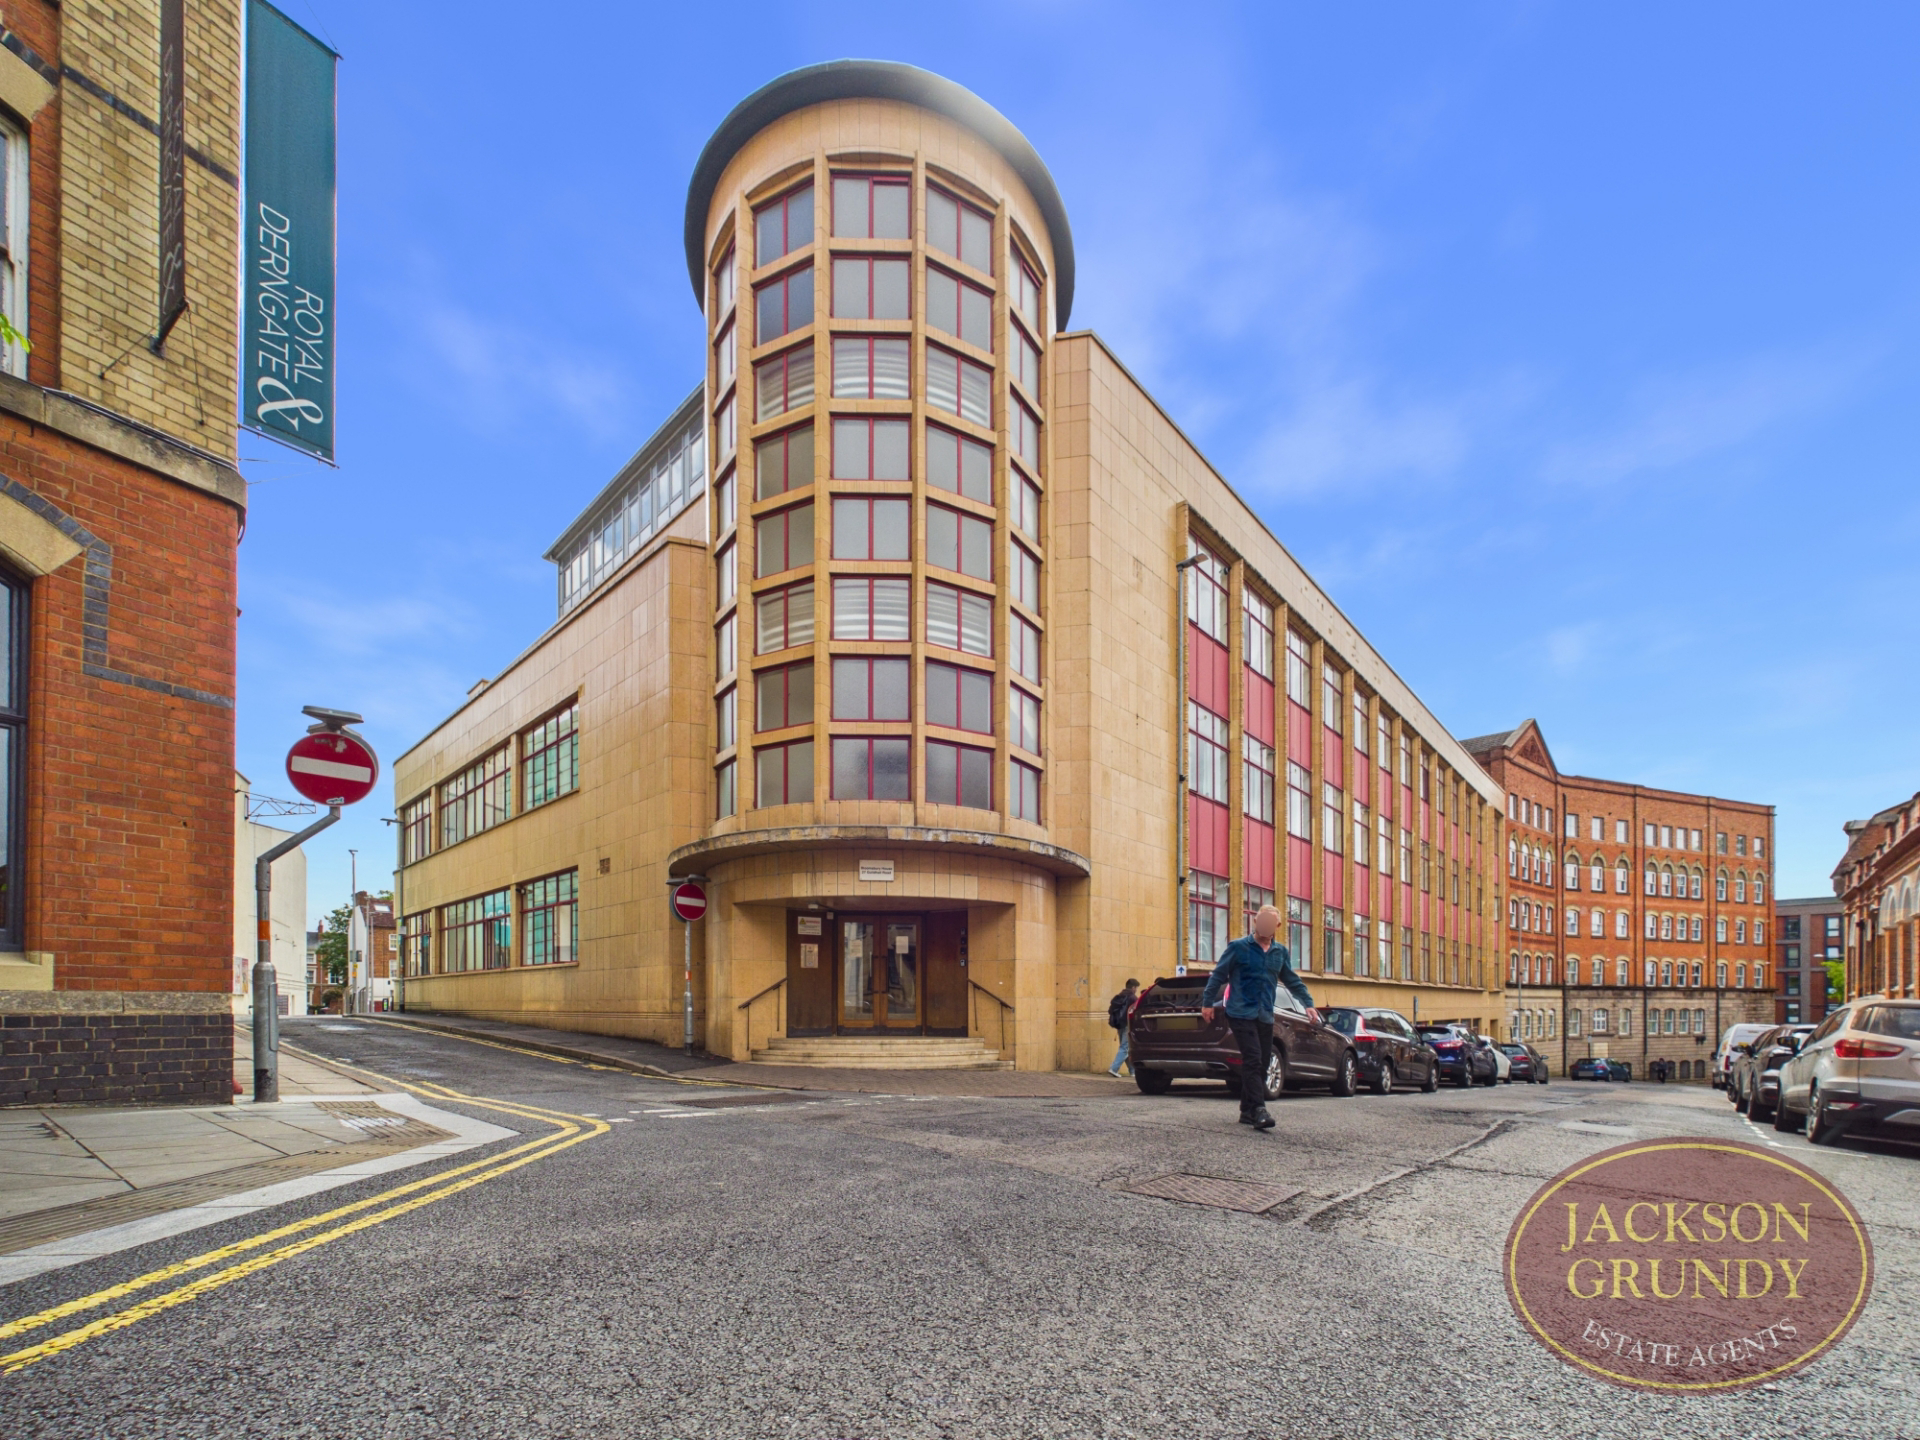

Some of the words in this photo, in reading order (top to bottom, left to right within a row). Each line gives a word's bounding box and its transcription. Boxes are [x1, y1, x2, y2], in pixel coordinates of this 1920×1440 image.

[258, 201, 290, 379] DERNGATE
[294, 285, 323, 383] ROYAL
[257, 376, 324, 432] &
